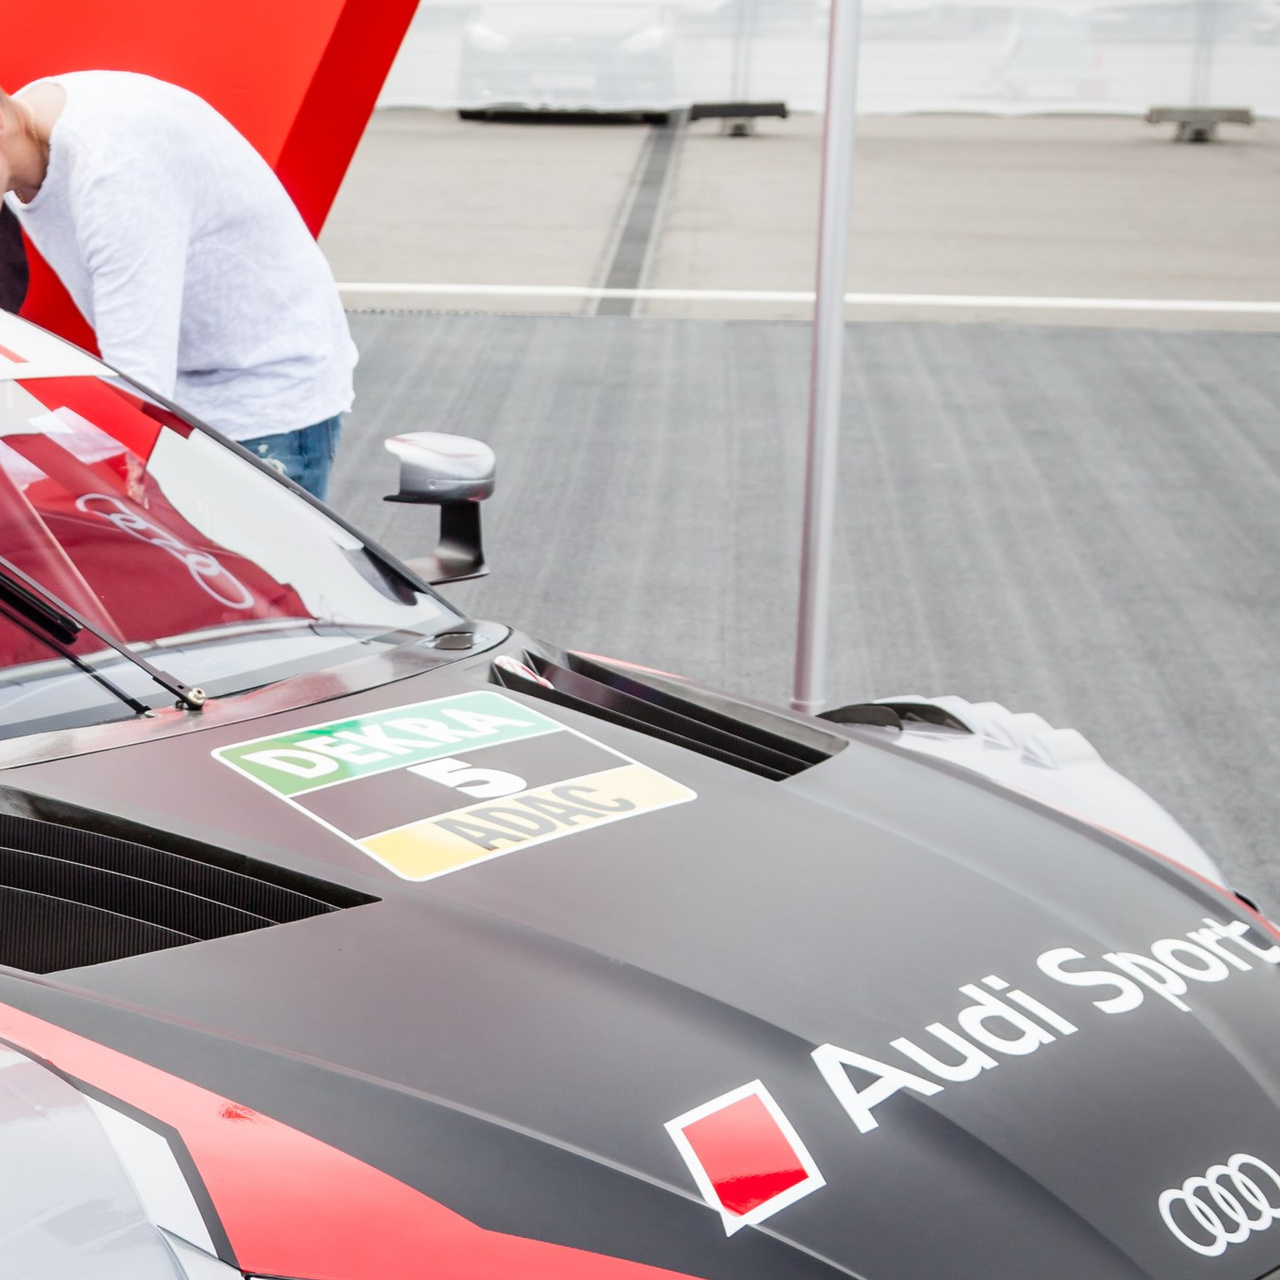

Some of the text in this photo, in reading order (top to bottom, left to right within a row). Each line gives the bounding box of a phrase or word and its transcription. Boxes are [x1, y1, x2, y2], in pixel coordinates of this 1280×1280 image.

[240, 707, 538, 780] DEKRA
[406, 757, 528, 799] 5
[433, 784, 637, 851] ADAC
[810, 917, 1280, 1134] Audi Sport
